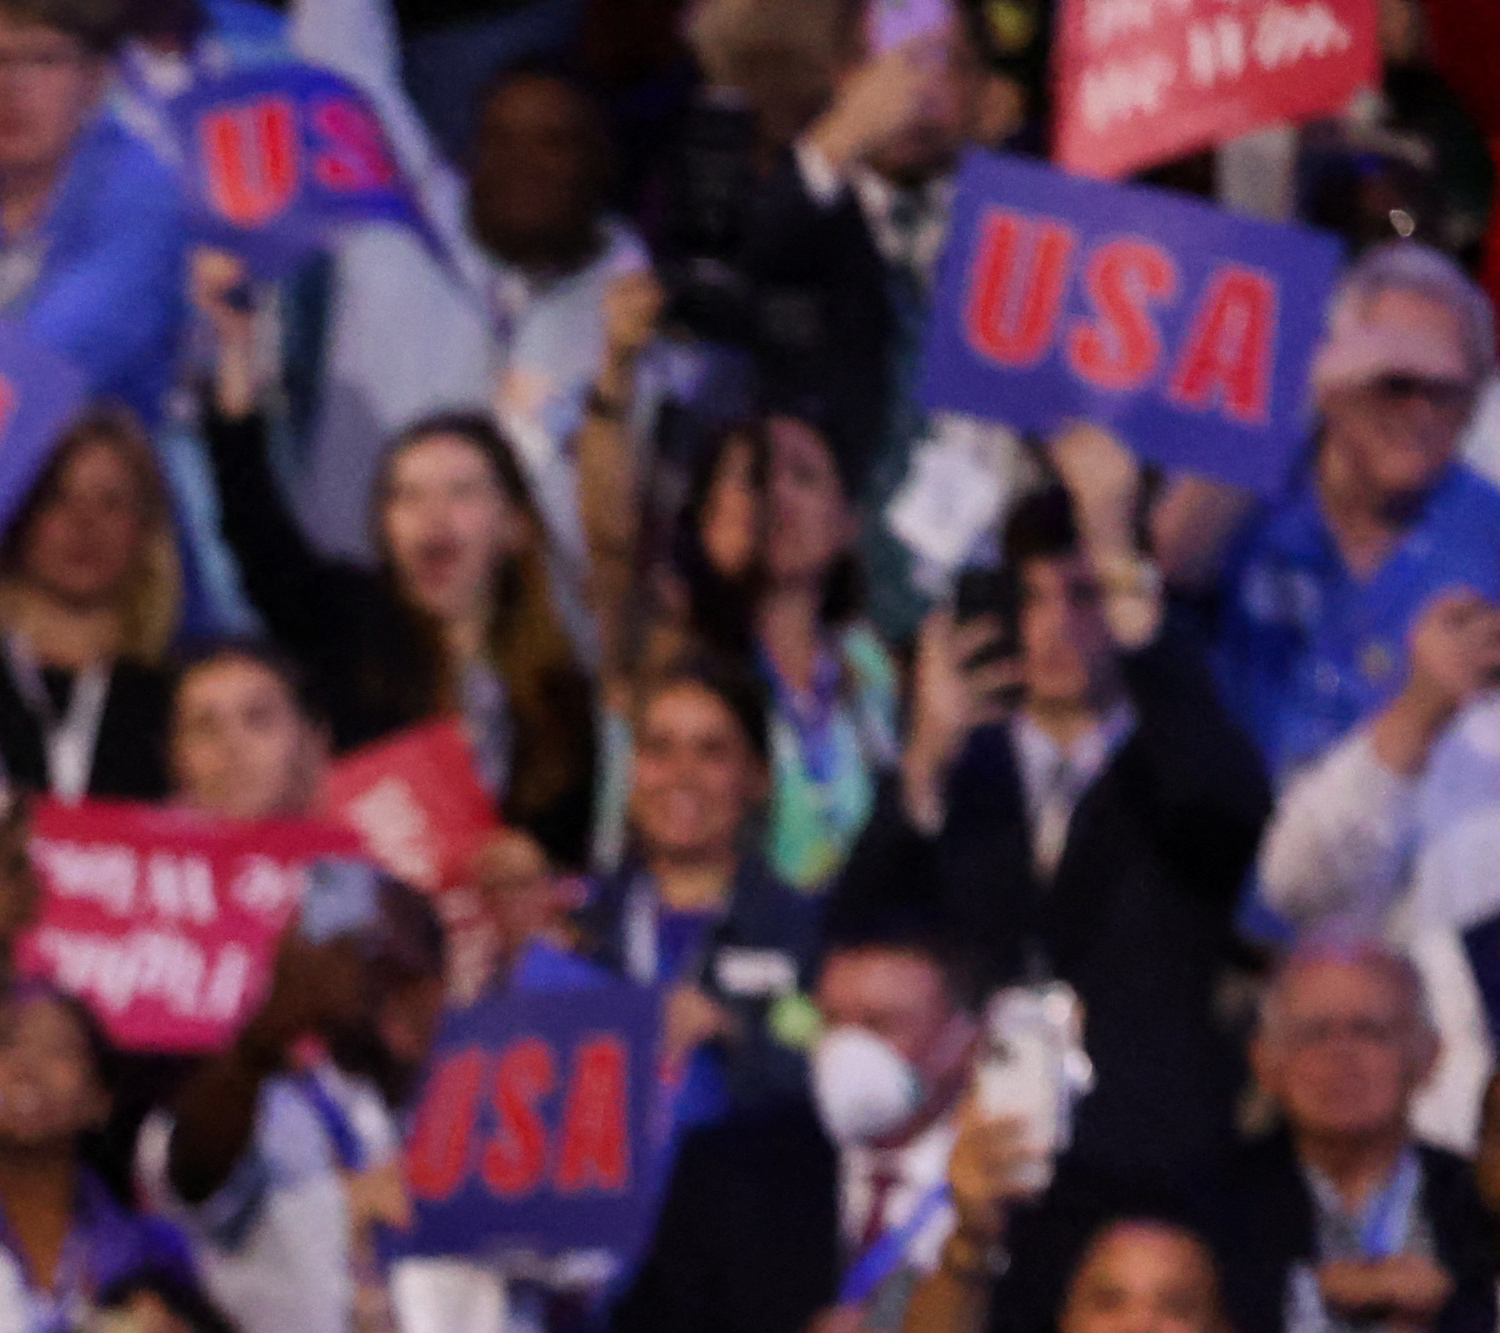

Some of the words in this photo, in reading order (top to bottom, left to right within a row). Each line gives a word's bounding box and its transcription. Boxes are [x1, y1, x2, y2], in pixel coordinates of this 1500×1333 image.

[200, 94, 395, 230] US
[962, 210, 1280, 426] USA
[405, 1034, 632, 1198] USA
